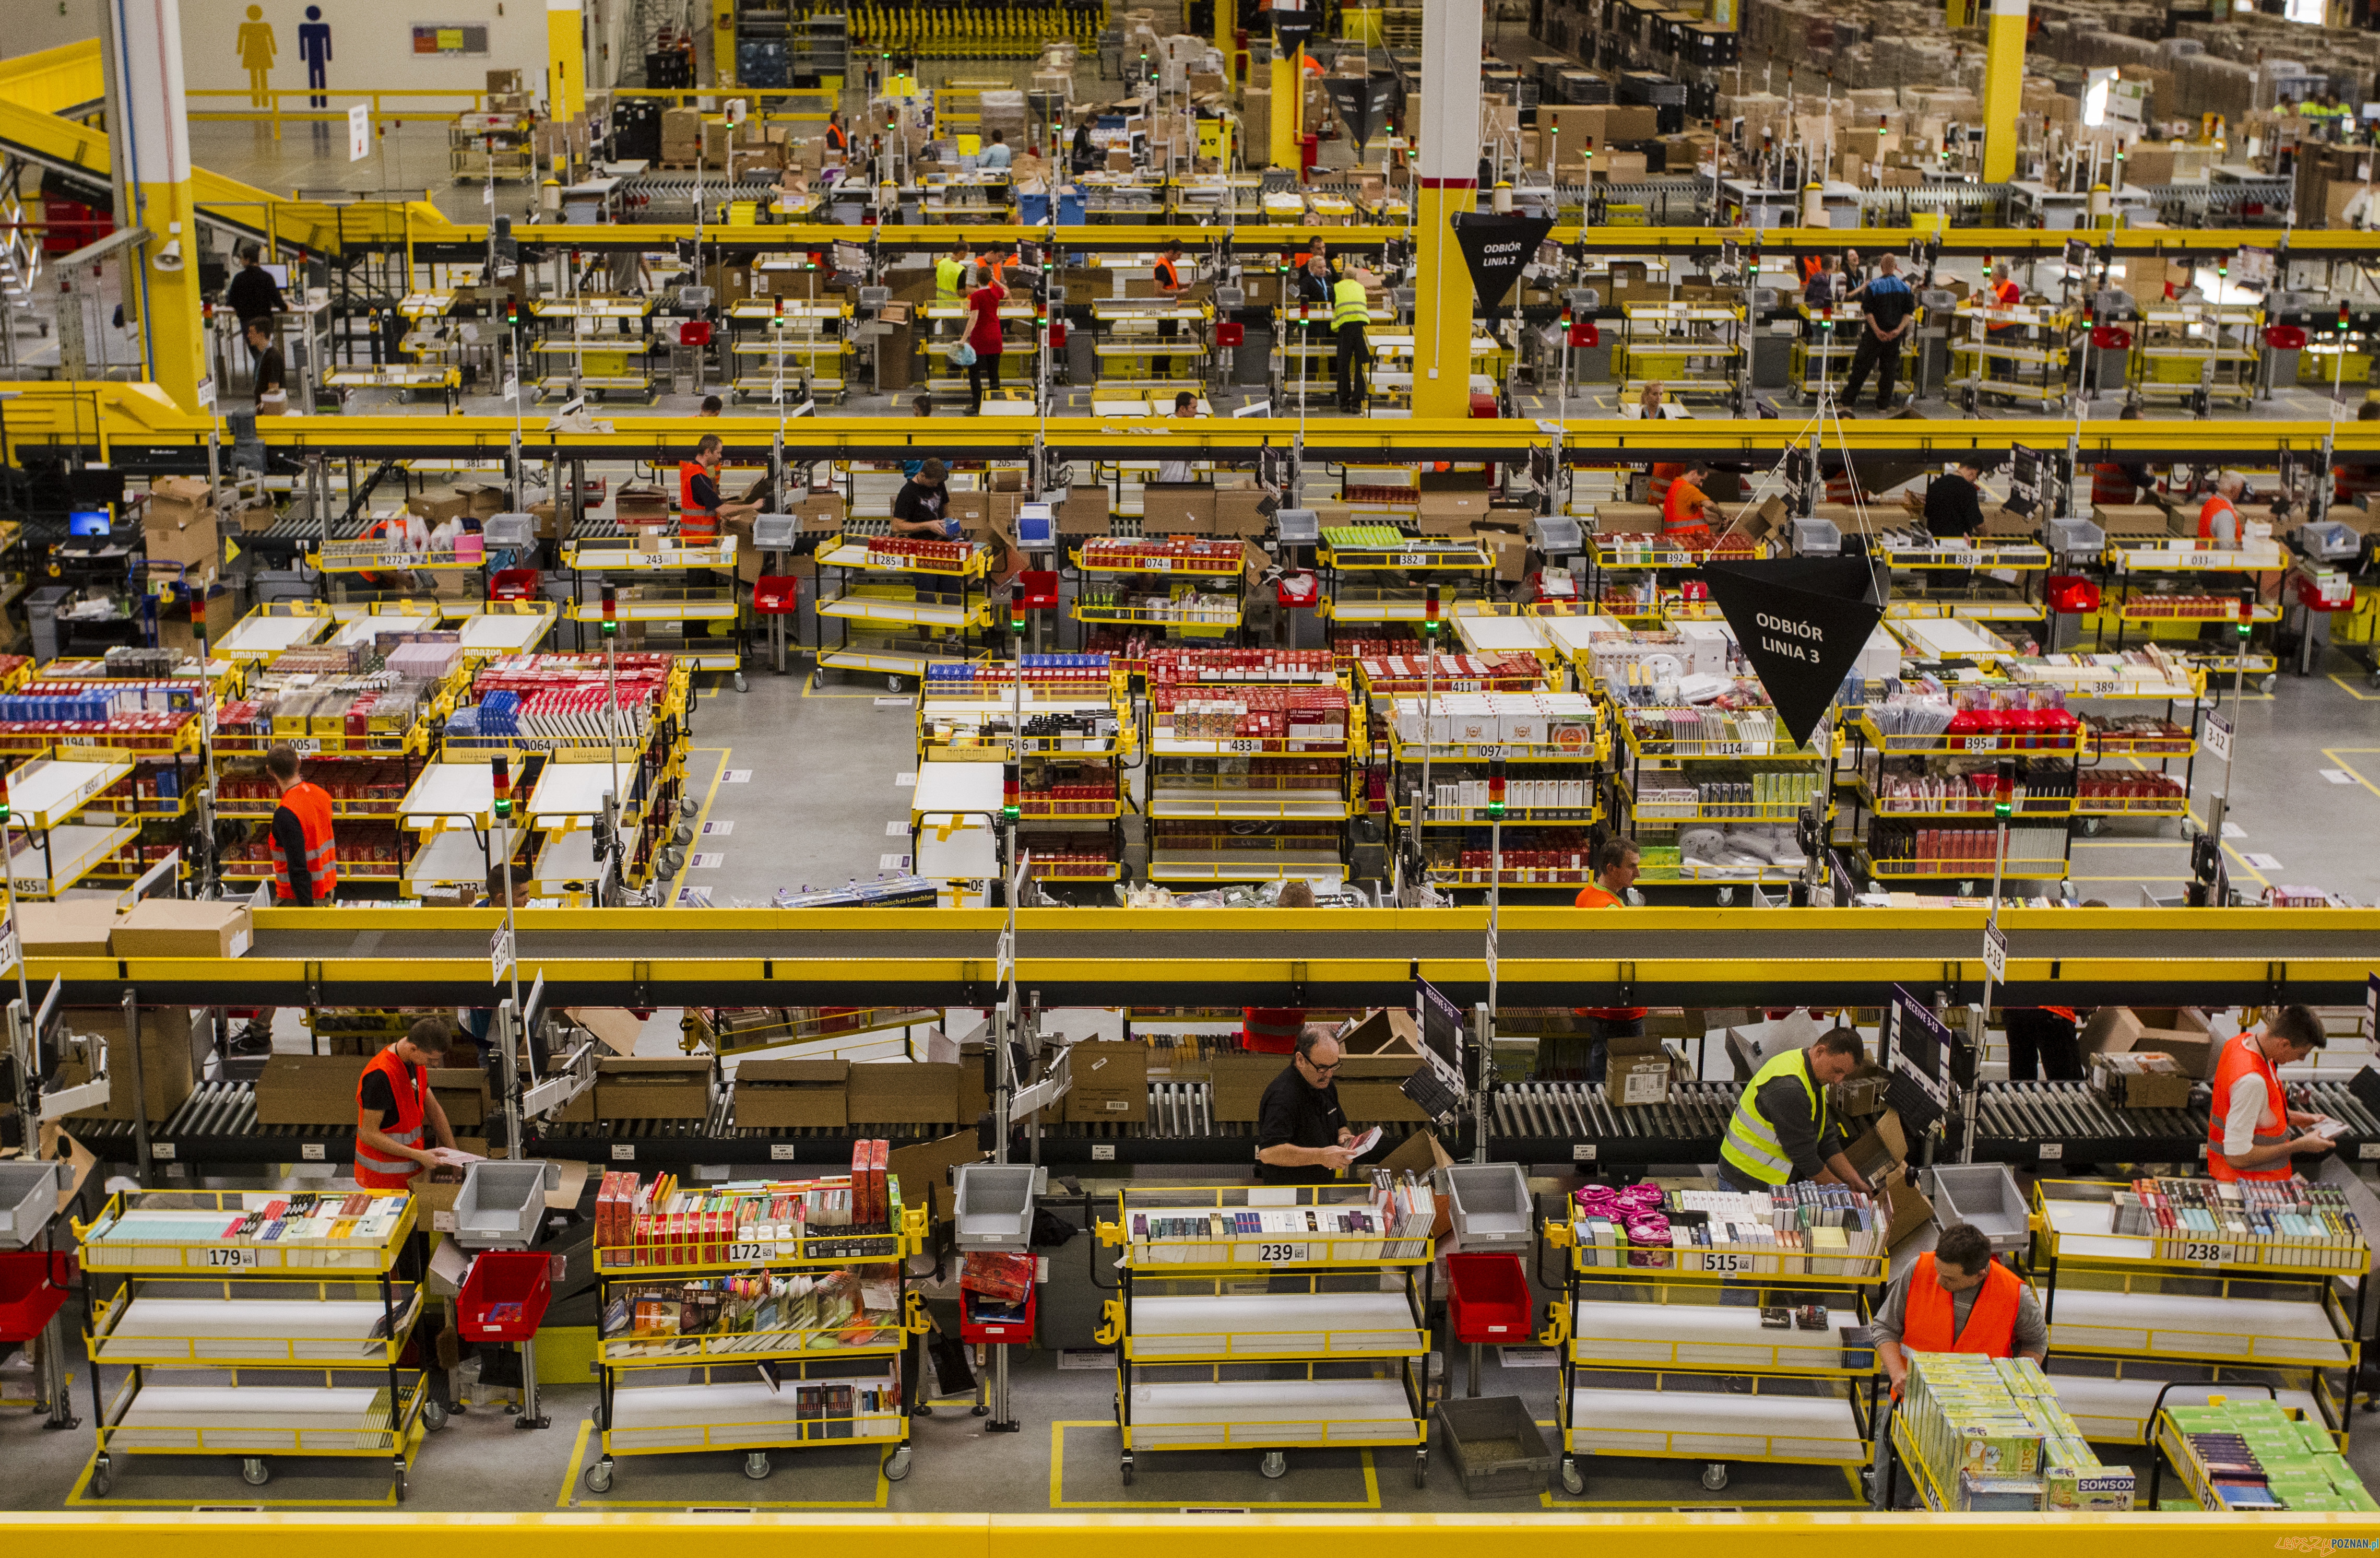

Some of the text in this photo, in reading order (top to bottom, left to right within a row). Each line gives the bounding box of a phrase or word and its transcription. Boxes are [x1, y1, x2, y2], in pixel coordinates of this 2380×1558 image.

[1484, 241, 1521, 253] ODBIÓR
[1483, 256, 1516, 267] LINIA 2
[387, 555, 402, 564] 272
[646, 554, 662, 564] 243
[881, 555, 896, 565] 285
[1146, 558, 1163, 567] 074
[1401, 555, 1418, 564] 382
[1668, 553, 1684, 562] 392
[1957, 554, 1973, 563] 383
[1756, 612, 1823, 642] ODBIÓR
[231, 651, 269, 659] amazon
[464, 648, 502, 657] amazon
[1762, 637, 1820, 663] LINIA 3
[1453, 682, 1472, 692] 411
[2094, 682, 2114, 692] 389
[2210, 711, 2226, 731] RECEIVE
[65, 737, 84, 746] 194
[290, 739, 310, 750] 005
[1009, 739, 1028, 750] 56
[1967, 738, 1987, 749] 395
[2208, 728, 2225, 751] 3-12
[530, 740, 551, 751] 064
[1232, 740, 1252, 751] 433
[1722, 743, 1742, 754] 114
[1481, 746, 1501, 757] 097
[18, 880, 38, 892] 455
[970, 880, 984, 891] 09
[870, 893, 935, 908] Chemisches Leuchten
[1988, 922, 2005, 948] RECEIVE
[1987, 940, 2001, 971] 3-13
[1426, 985, 1454, 1018] RECEIVE 3-15
[1905, 997, 1938, 1035] RECEIVE 3-13
[210, 1249, 241, 1265] 179
[732, 1244, 761, 1260] 172
[1262, 1244, 1293, 1260] 239
[2187, 1244, 2220, 1260] 238
[1706, 1254, 1737, 1270] 515
[2080, 1479, 2135, 1491] KOSMOS
